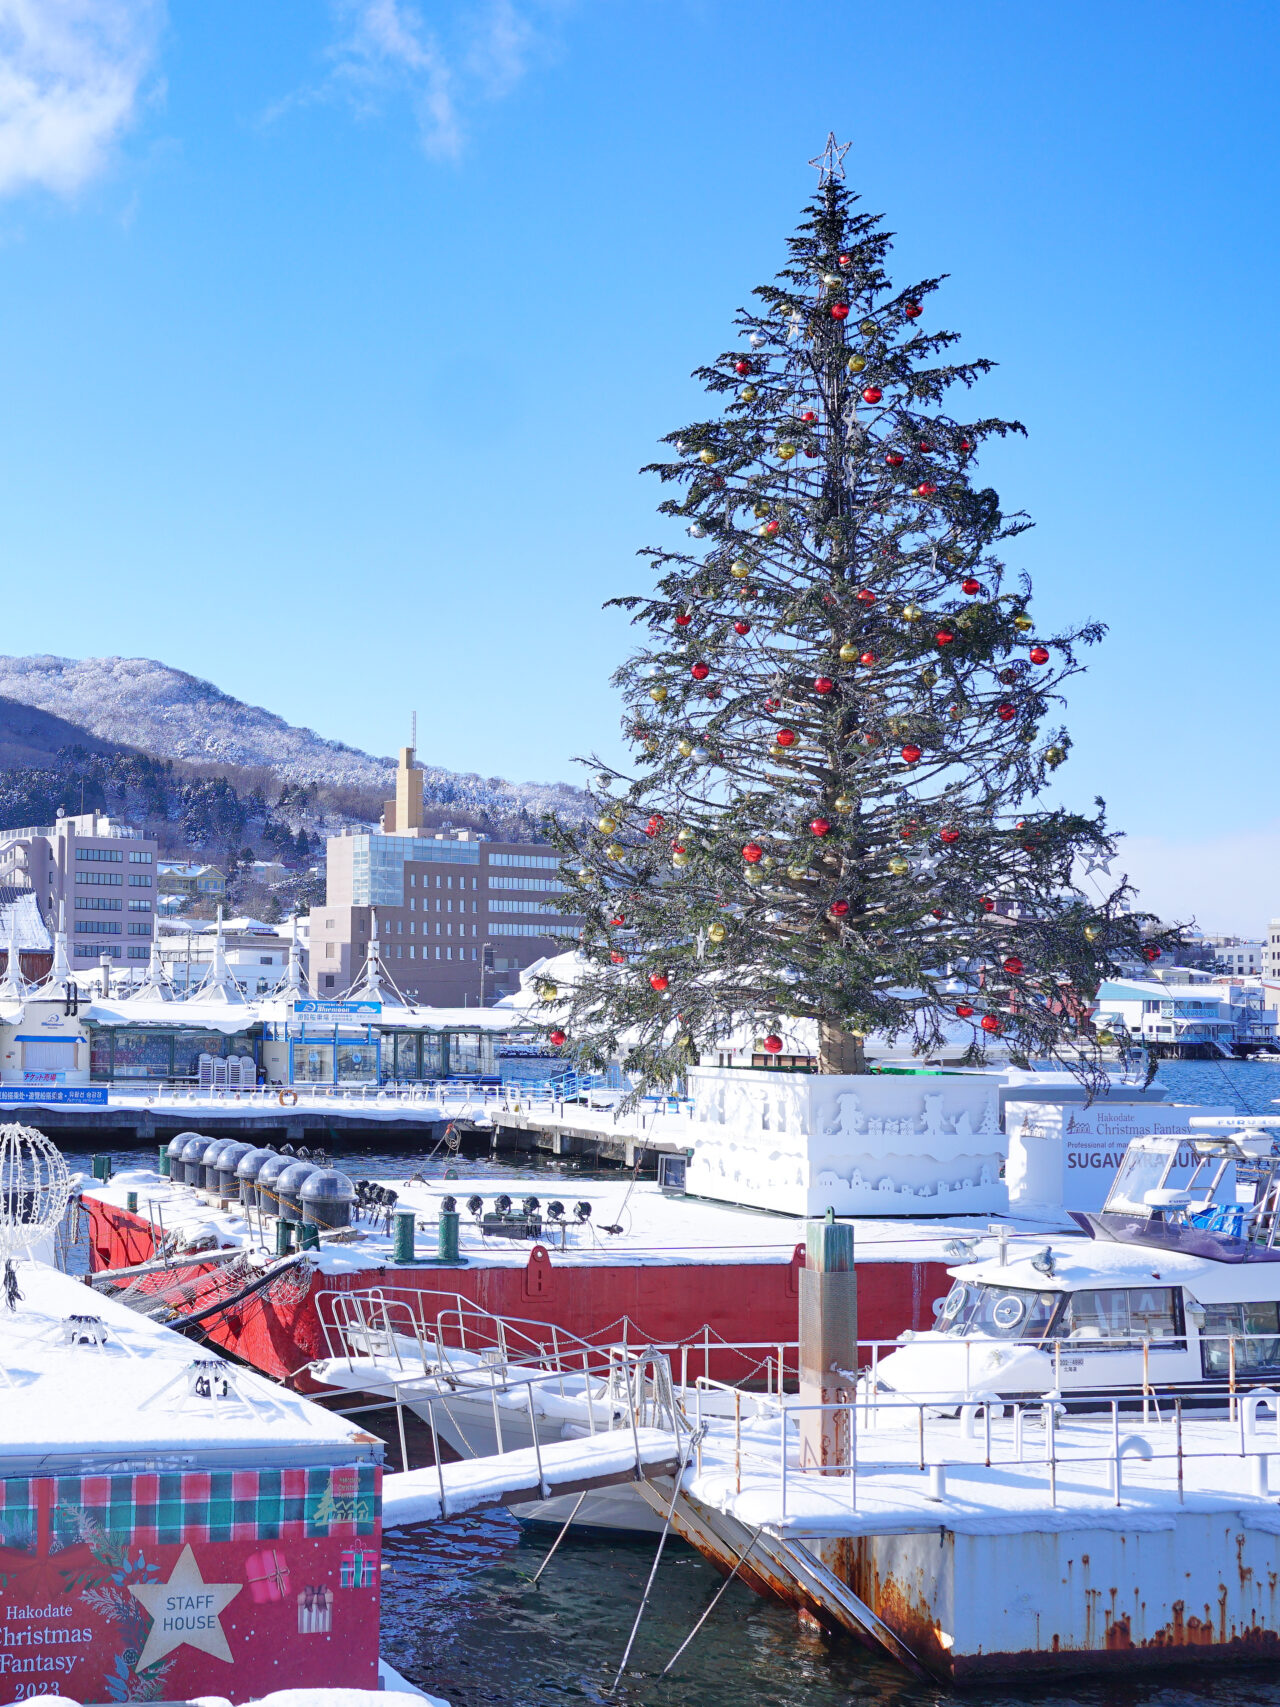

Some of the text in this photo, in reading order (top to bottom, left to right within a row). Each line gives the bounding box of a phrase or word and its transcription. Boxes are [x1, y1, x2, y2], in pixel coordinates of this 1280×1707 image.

[24, 1073, 57, 1082] チケット売場
[1097, 1112, 1135, 1122] Hakodate
[1096, 1123, 1193, 1135] Christmas Fantasy
[1067, 1141, 1106, 1149] Professional
[1108, 1141, 1115, 1149] of
[166, 1594, 215, 1611] STAFF
[6, 1604, 73, 1621] Hakodate
[163, 1615, 216, 1631] HOUSE
[14, 1681, 61, 1701] 2023
